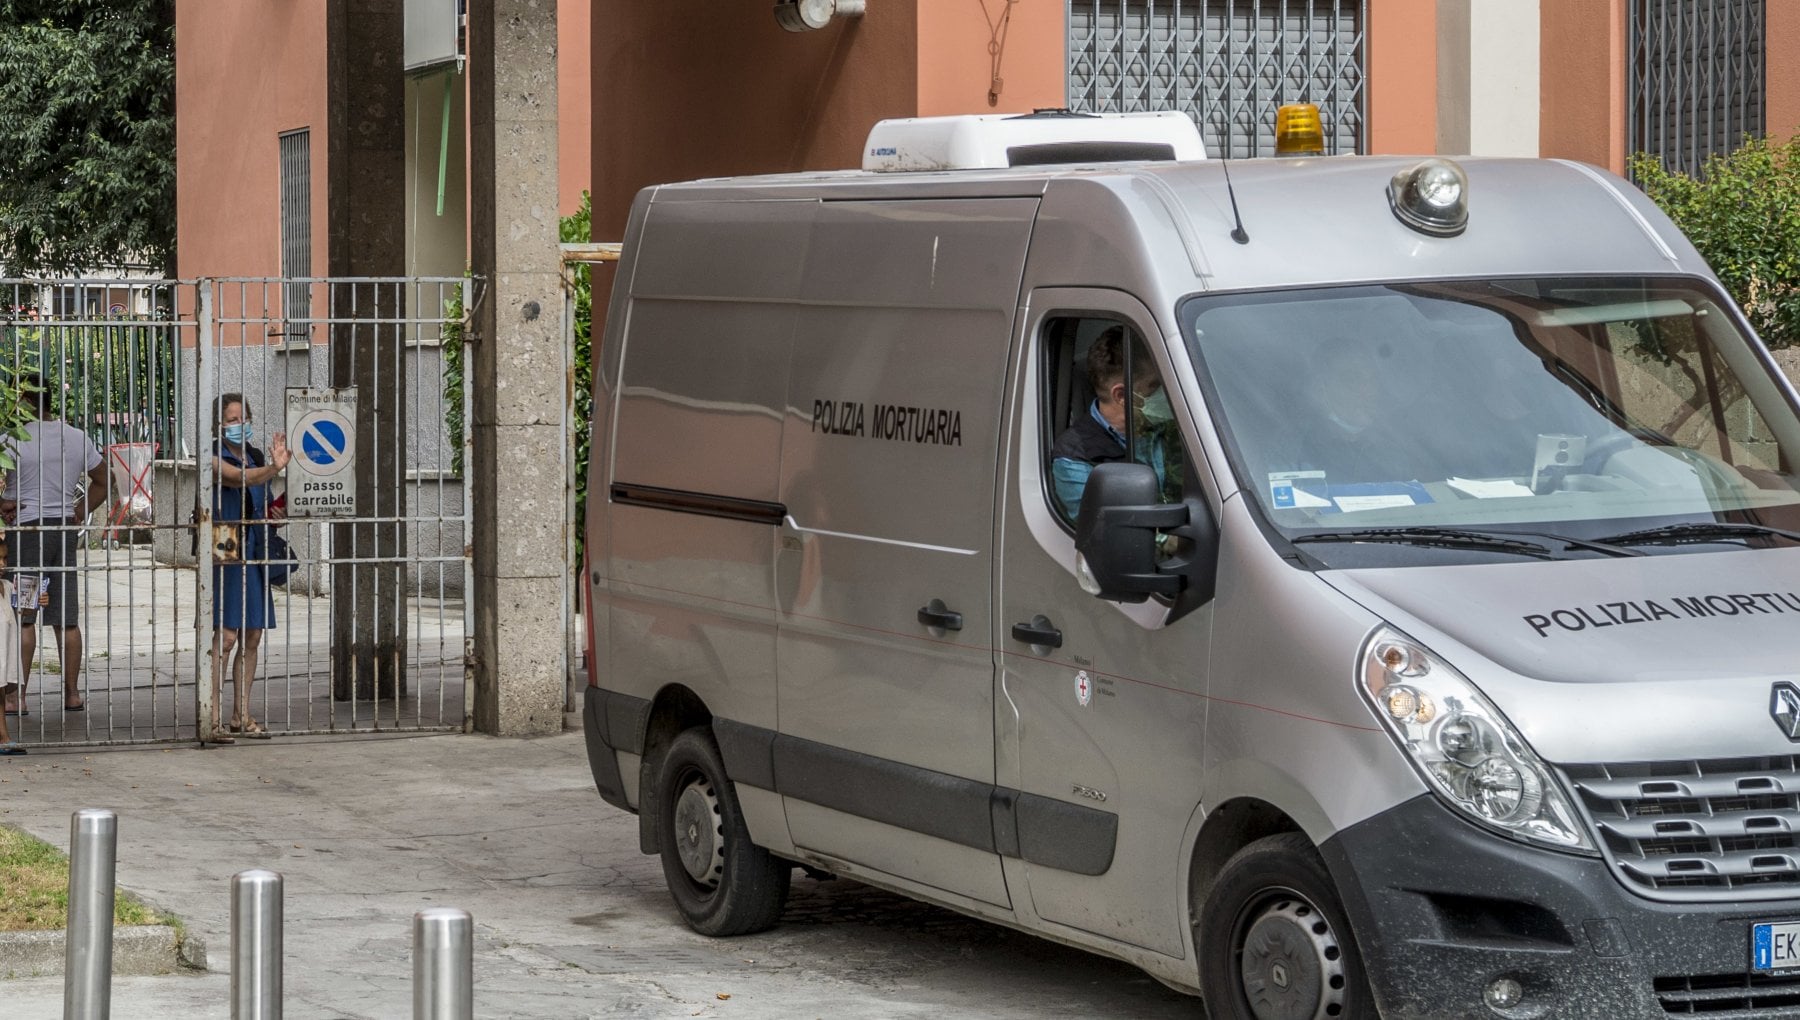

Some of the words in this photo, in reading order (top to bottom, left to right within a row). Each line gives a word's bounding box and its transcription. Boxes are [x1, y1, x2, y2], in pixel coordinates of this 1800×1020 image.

[289, 394, 321, 404] Comune
[323, 395, 331, 404] di
[812, 399, 865, 437] POLIZIA
[872, 404, 962, 447] MORTUARIA
[304, 482, 343, 494] passo
[294, 494, 354, 506] carrabile
[1522, 600, 1680, 638] POLIZIA
